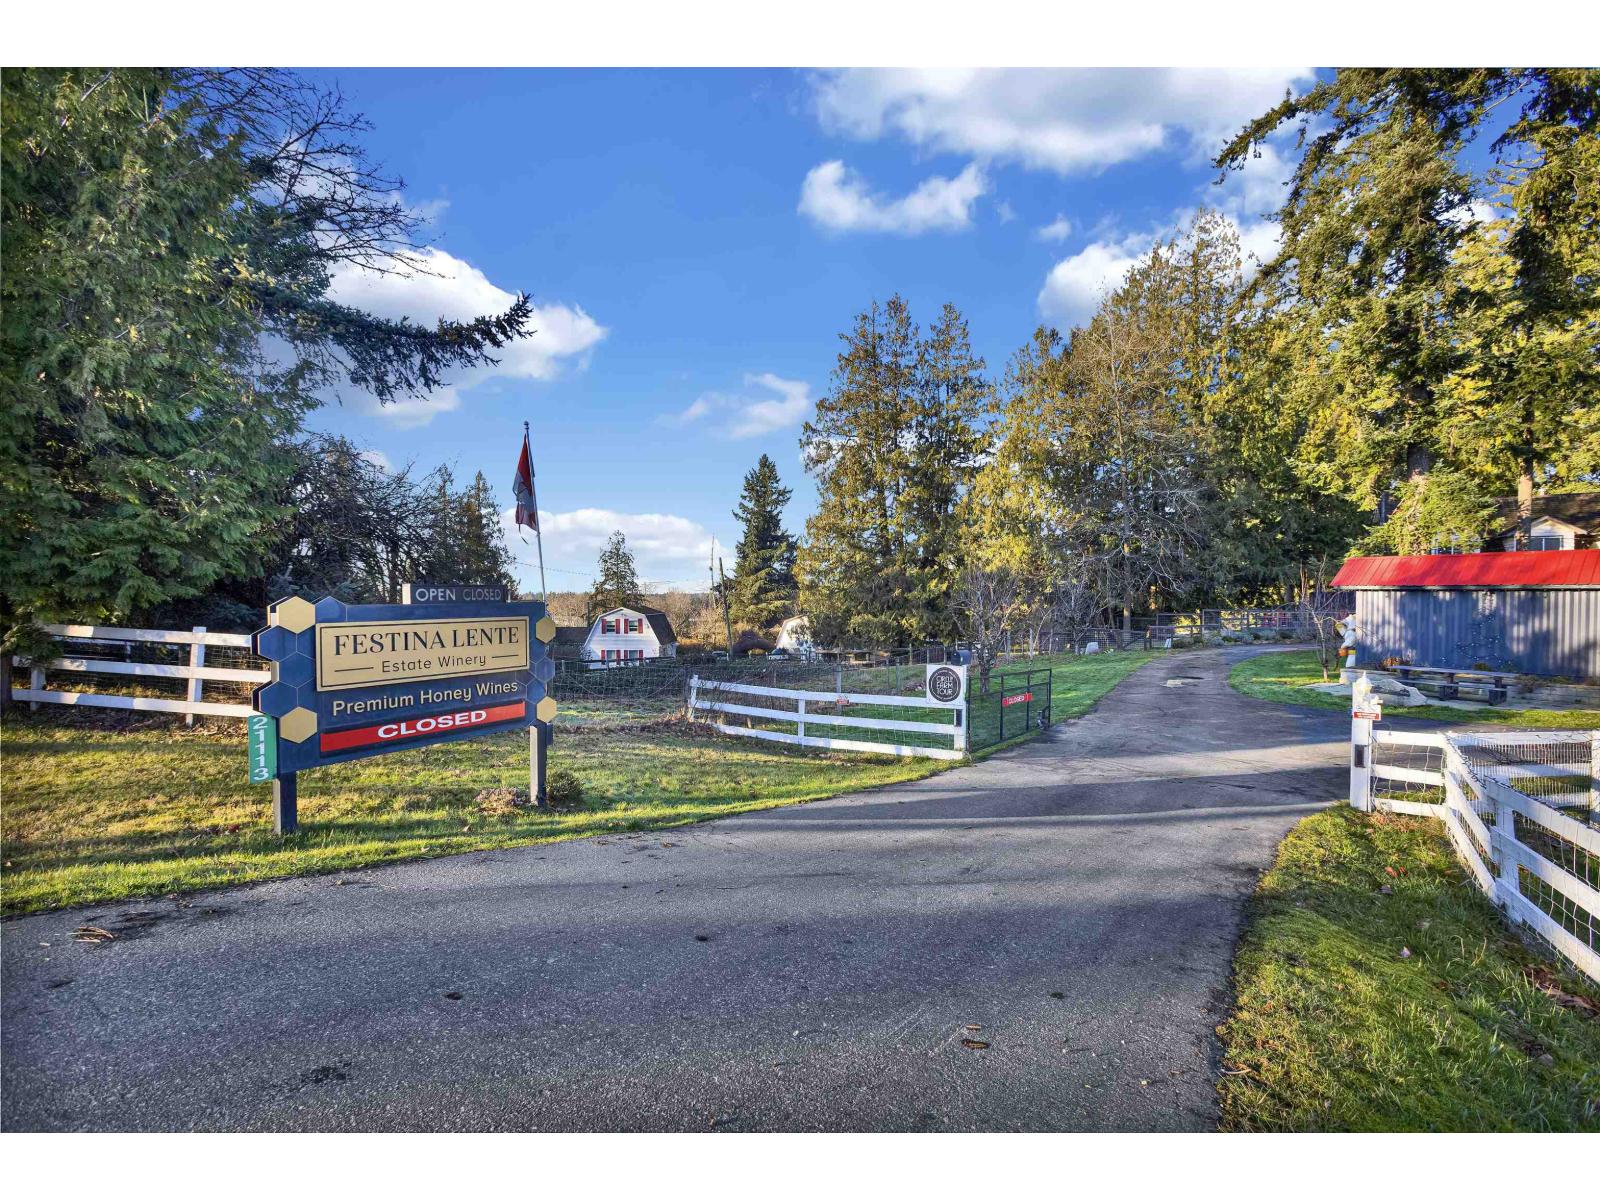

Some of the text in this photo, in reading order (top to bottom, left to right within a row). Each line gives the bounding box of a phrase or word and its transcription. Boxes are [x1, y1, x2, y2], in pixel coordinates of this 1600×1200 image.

[415, 588, 502, 601] OPEN CLOSED
[334, 626, 519, 656] FESTINA LENTE
[381, 654, 486, 673] Estate Winery
[333, 681, 518, 717] Premium Honey Wines
[377, 710, 487, 738] CLOSED
[252, 716, 269, 781] 21113
